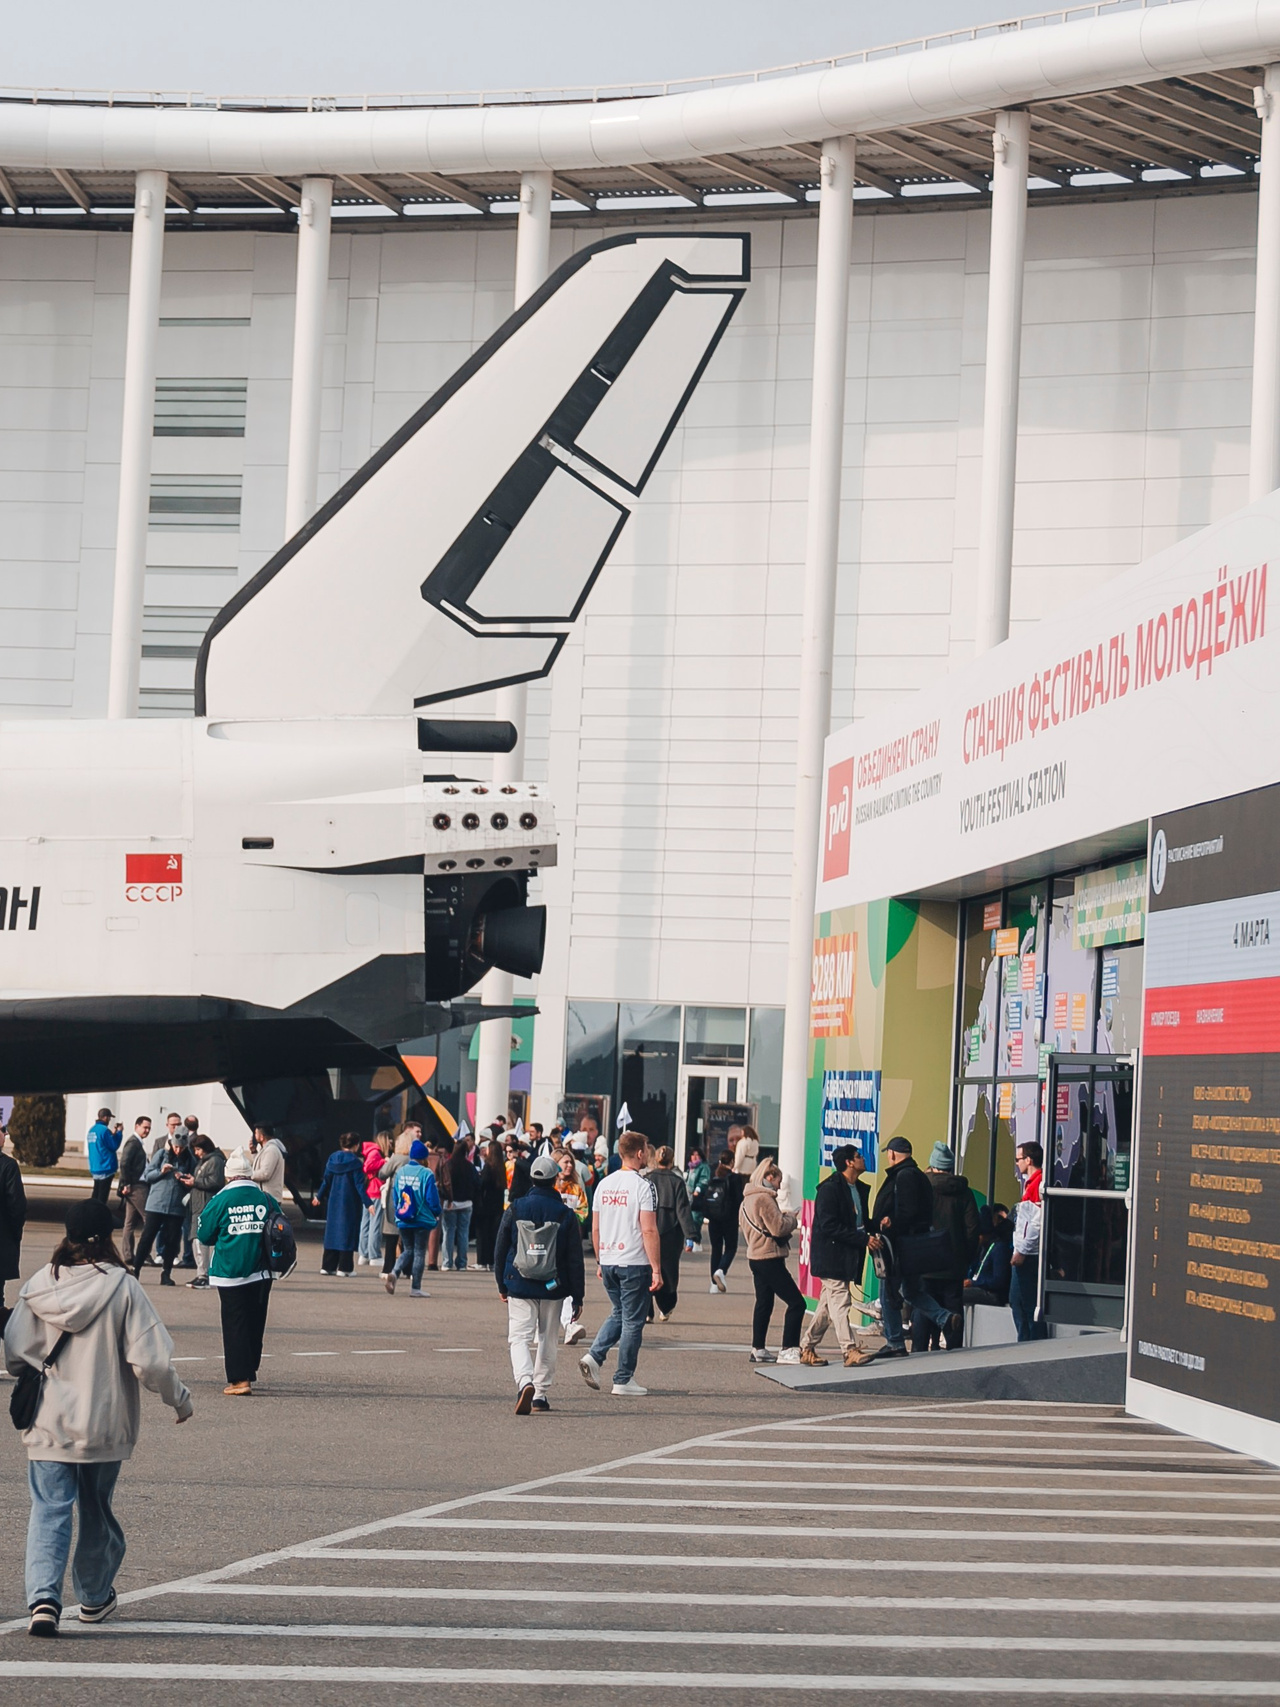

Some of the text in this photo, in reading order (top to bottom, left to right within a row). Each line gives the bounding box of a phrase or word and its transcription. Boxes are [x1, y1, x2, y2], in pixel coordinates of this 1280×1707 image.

[962, 563, 1267, 764] СТАНЦИЯ ФЕСТИВАЛЬ МОЛОДЁЖИ
[857, 719, 941, 790] ОБЪЕДИНЯЕМ СТРАНУ
[920, 772, 943, 800] COUNTRY
[959, 760, 1067, 834] YOUTH FESTIVAL STATION
[125, 886, 183, 902] СССР
[1233, 919, 1270, 948] 4 МАРТА
[812, 953, 835, 1001] 9288
[228, 1204, 255, 1214] MORE
[602, 1196, 628, 1206] РЖД
[229, 1214, 253, 1223] THAN
[239, 1223, 263, 1231] GUIDE
